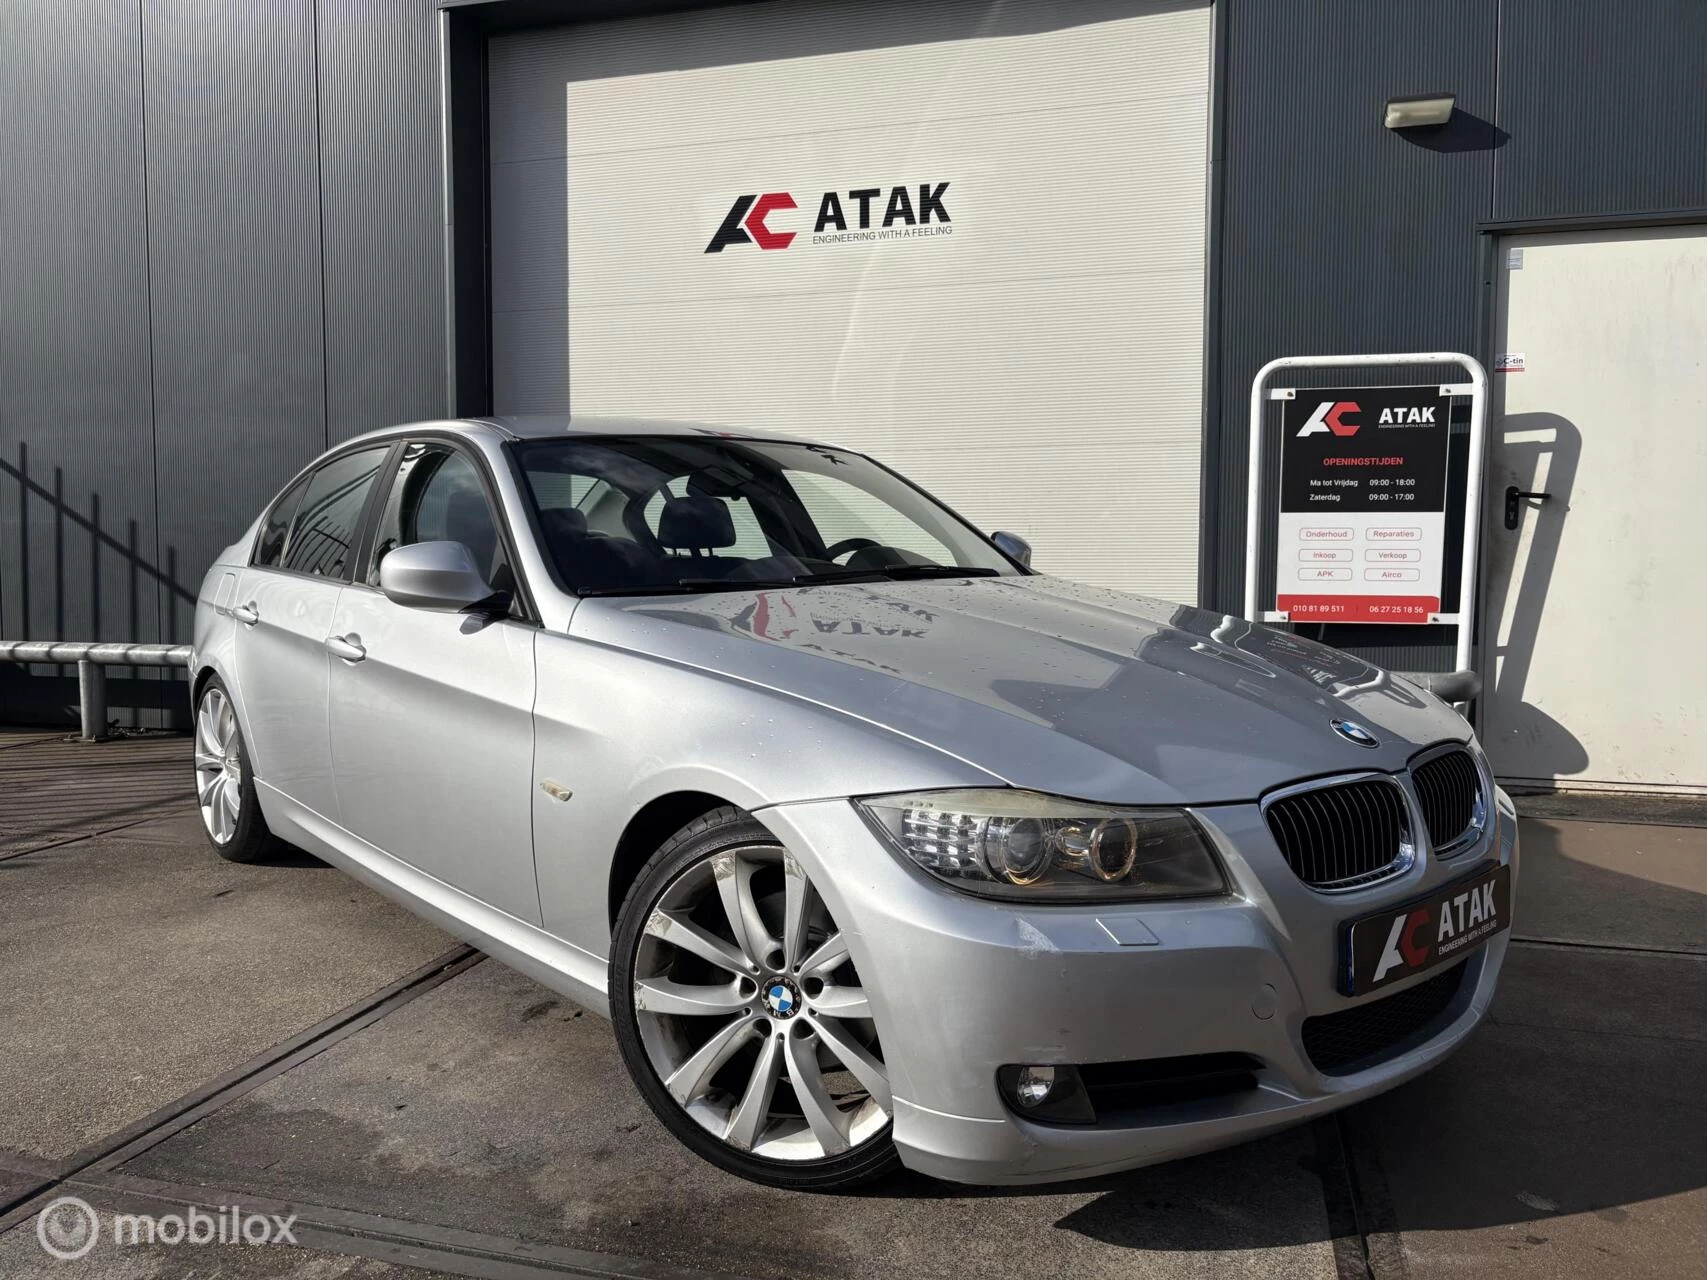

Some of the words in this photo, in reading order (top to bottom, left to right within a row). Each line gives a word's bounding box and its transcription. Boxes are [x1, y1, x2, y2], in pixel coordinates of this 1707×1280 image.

[814, 182, 952, 232] ATAK
[812, 231, 876, 245] ENGINEERING
[878, 229, 901, 240] WITH
[904, 228, 911, 238] A
[912, 226, 953, 237] FEELING
[1378, 406, 1436, 423] ATAK
[1323, 457, 1404, 466] OPENINGSTIJDEN
[1334, 480, 1359, 488] Vrijdag
[1309, 494, 1341, 502] Zaterdag
[1373, 531, 1415, 539] Reparaties
[1313, 551, 1337, 559] Inkoop
[1378, 552, 1408, 560] Verkoop
[1438, 880, 1496, 943] ATAK
[1438, 934, 1468, 956] ENGINEERING
[1481, 919, 1497, 934] FEELING
